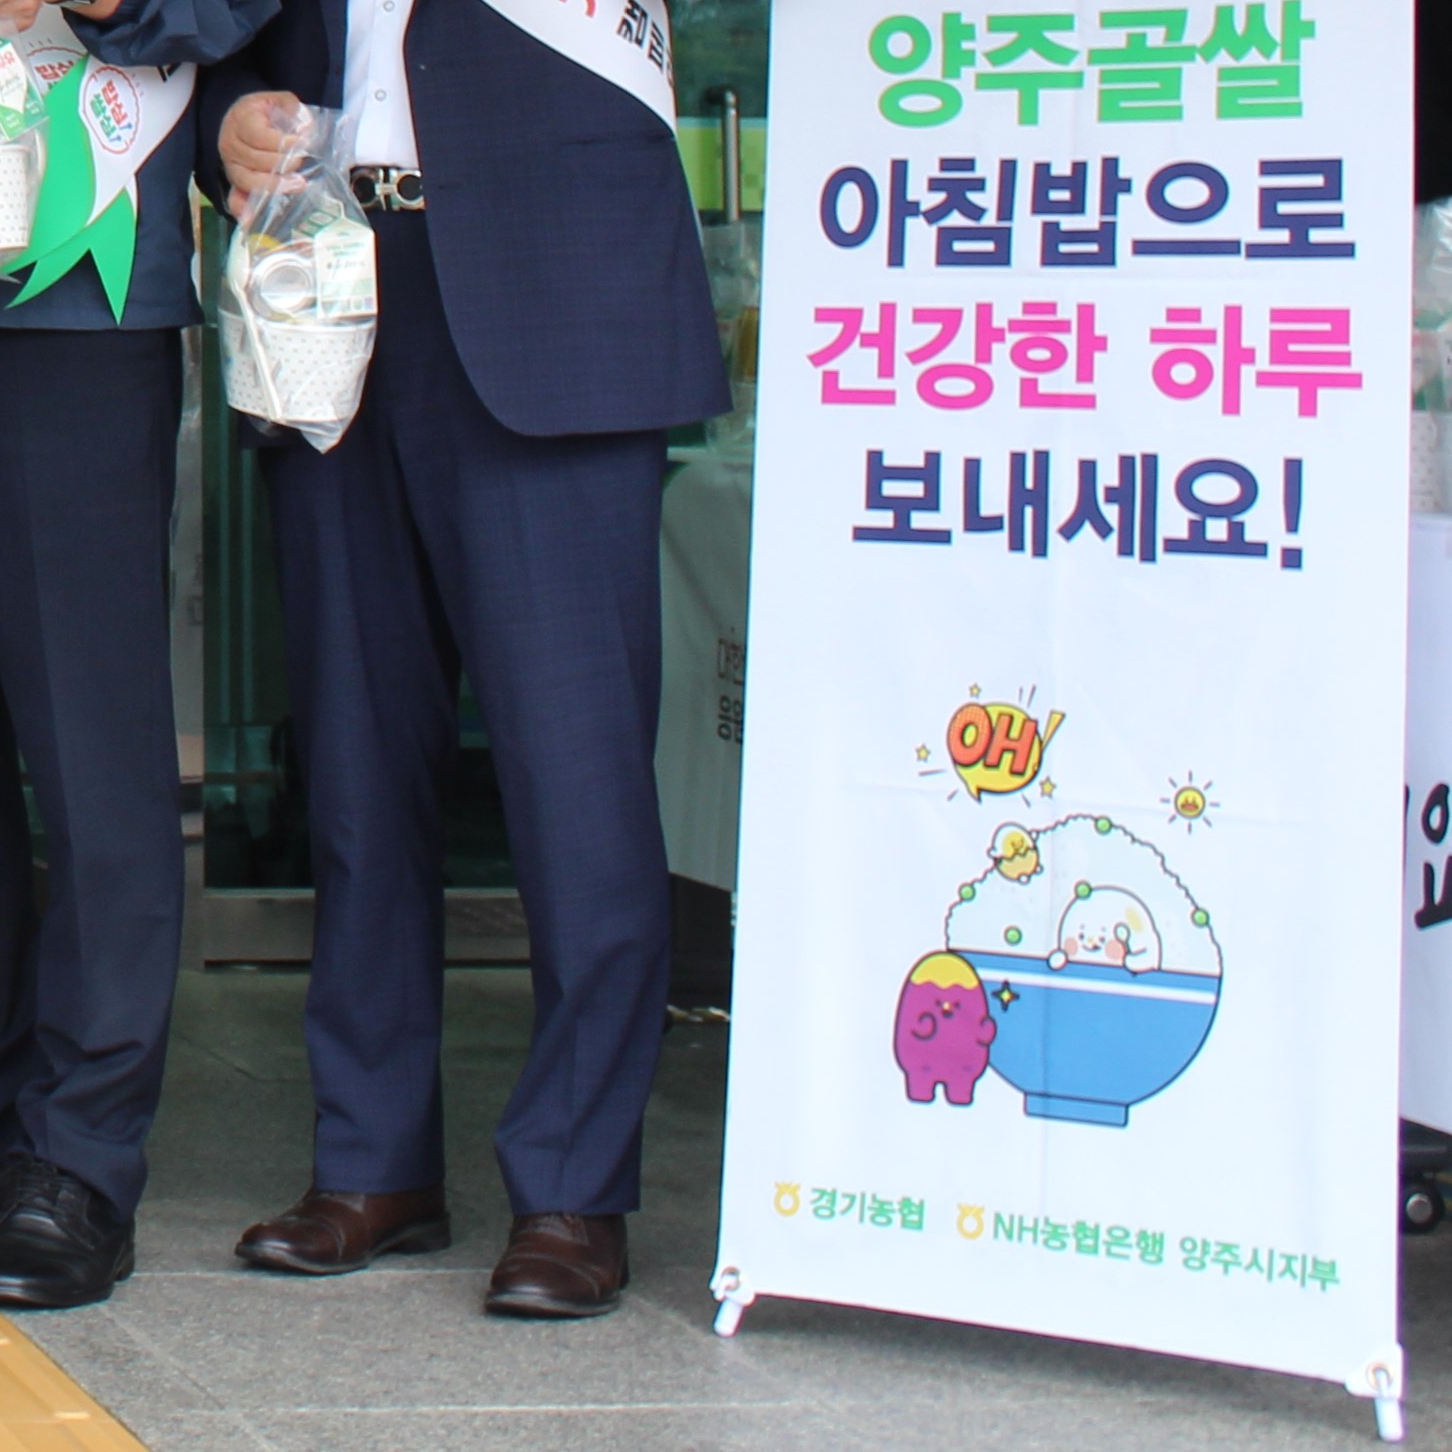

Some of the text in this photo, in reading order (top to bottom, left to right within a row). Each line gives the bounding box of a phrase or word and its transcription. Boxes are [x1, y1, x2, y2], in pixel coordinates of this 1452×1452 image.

[867, 0, 1316, 128] 양주골쌀
[819, 156, 1356, 268] 아침밥으로
[806, 300, 1363, 418] 건강한 하루
[851, 449, 1304, 571] 보내세요!
[809, 1187, 926, 1232] 경기농협
[992, 1211, 1341, 1290] NH농협은행 양주시지부
